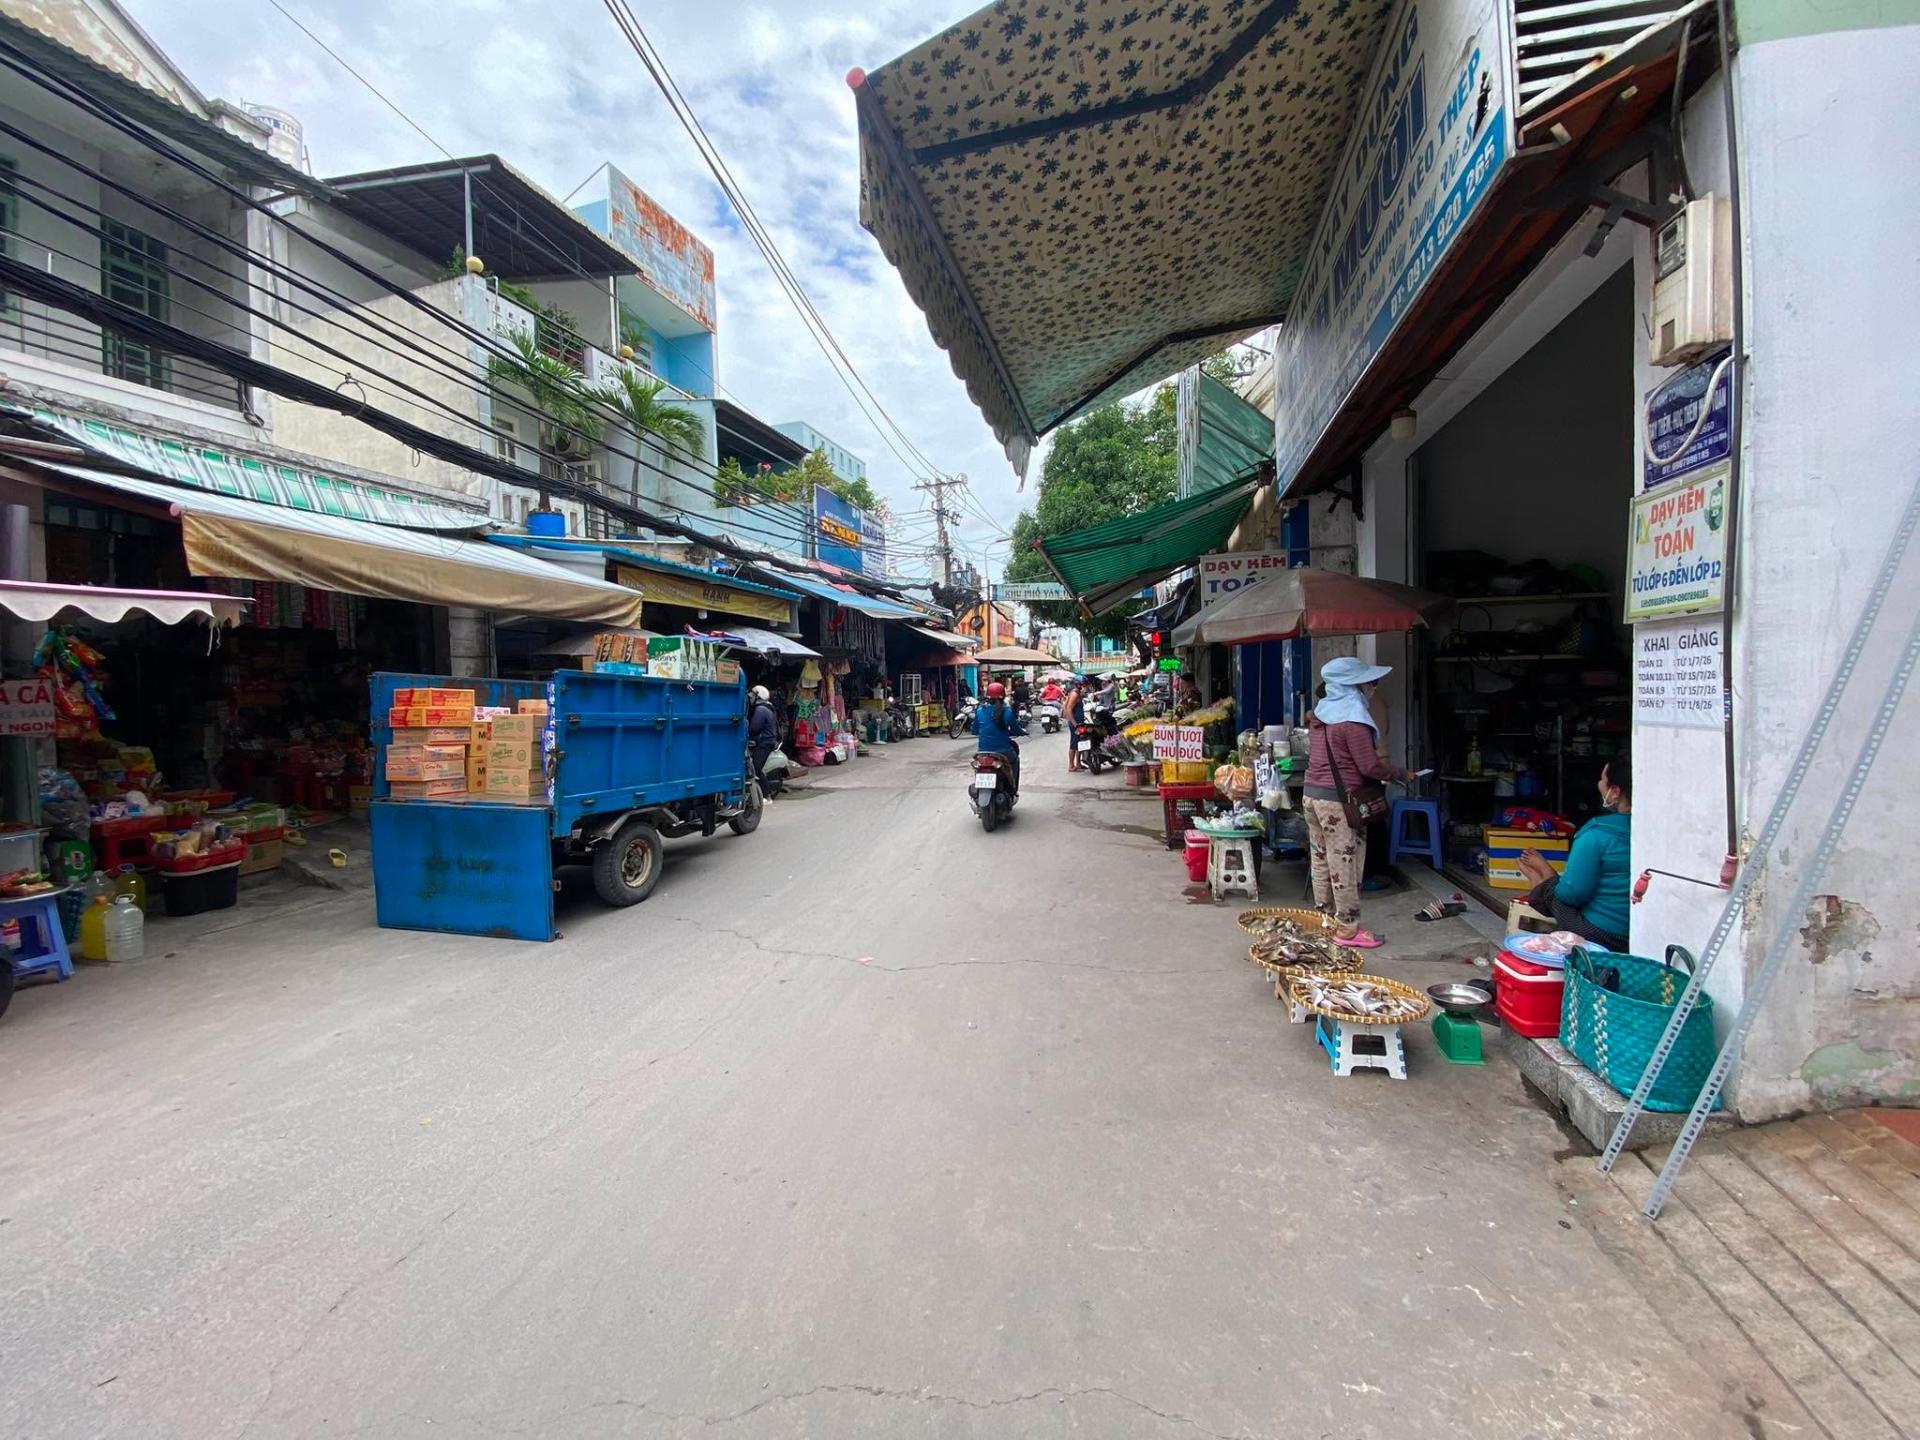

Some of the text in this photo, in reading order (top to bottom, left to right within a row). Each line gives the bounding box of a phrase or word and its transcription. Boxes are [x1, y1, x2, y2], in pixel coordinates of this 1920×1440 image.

[1355, 5, 1419, 183] DỰNG
[1368, 198, 1405, 279] KHUNG
[1438, 47, 1480, 146] THÉP
[1331, 52, 1427, 318] MƯỜI
[1409, 198, 1435, 250] Dựng
[1407, 241, 1434, 292] 0913
[1436, 203, 1460, 246] 920
[1651, 498, 1674, 528] DẠY
[1654, 517, 1694, 559] TOÁN
[1205, 561, 1242, 574] DẠY
[1207, 571, 1266, 593] TOÁ
[1632, 555, 1722, 593] TỪ LỚP 6 ĐẾN LỚP 12
[1644, 628, 1719, 652] KHAI GIẢNG
[1688, 670, 1717, 682] 15/7/26
[1688, 685, 1717, 696] 15/7/26
[1154, 726, 1175, 740] BÚN
[1155, 743, 1202, 760] THỦ ĐỨC
